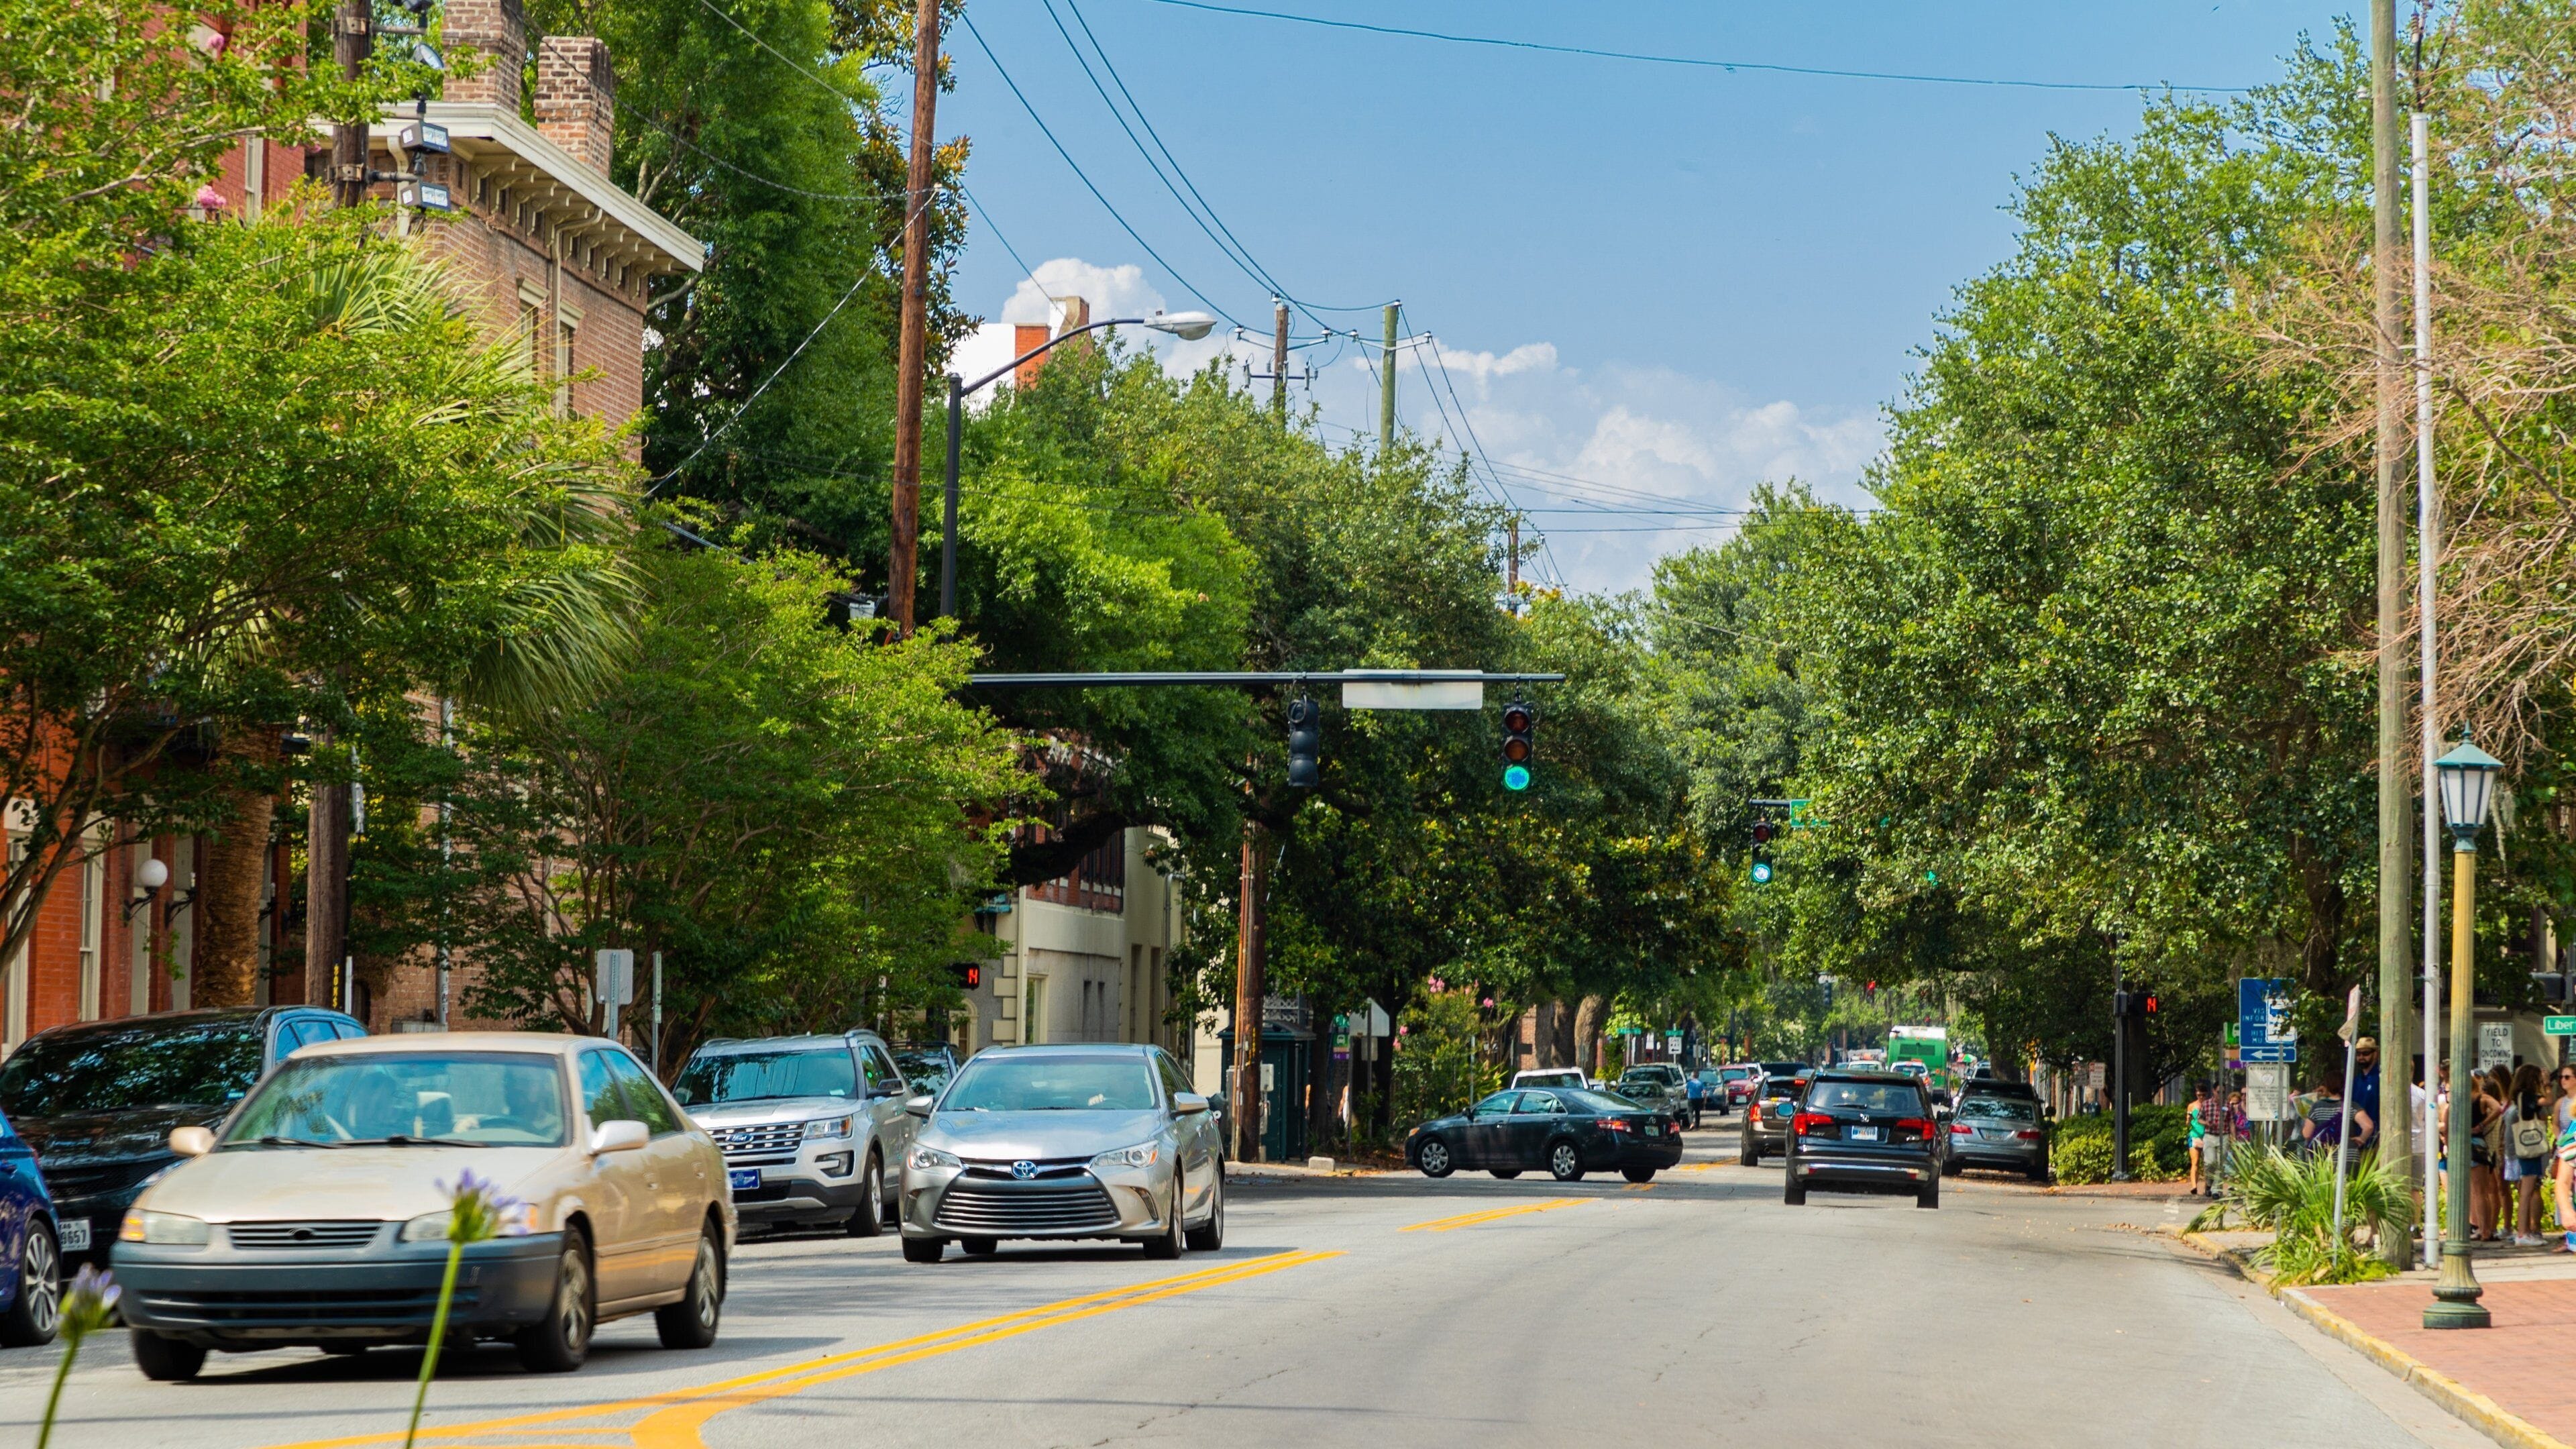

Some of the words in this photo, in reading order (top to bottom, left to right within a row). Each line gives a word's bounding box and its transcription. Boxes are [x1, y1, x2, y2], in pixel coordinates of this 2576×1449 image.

[2484, 1028, 2508, 1036] YIELD
[2491, 1038, 2501, 1046] TO
[2481, 1049, 2511, 1058] ONCOMING
